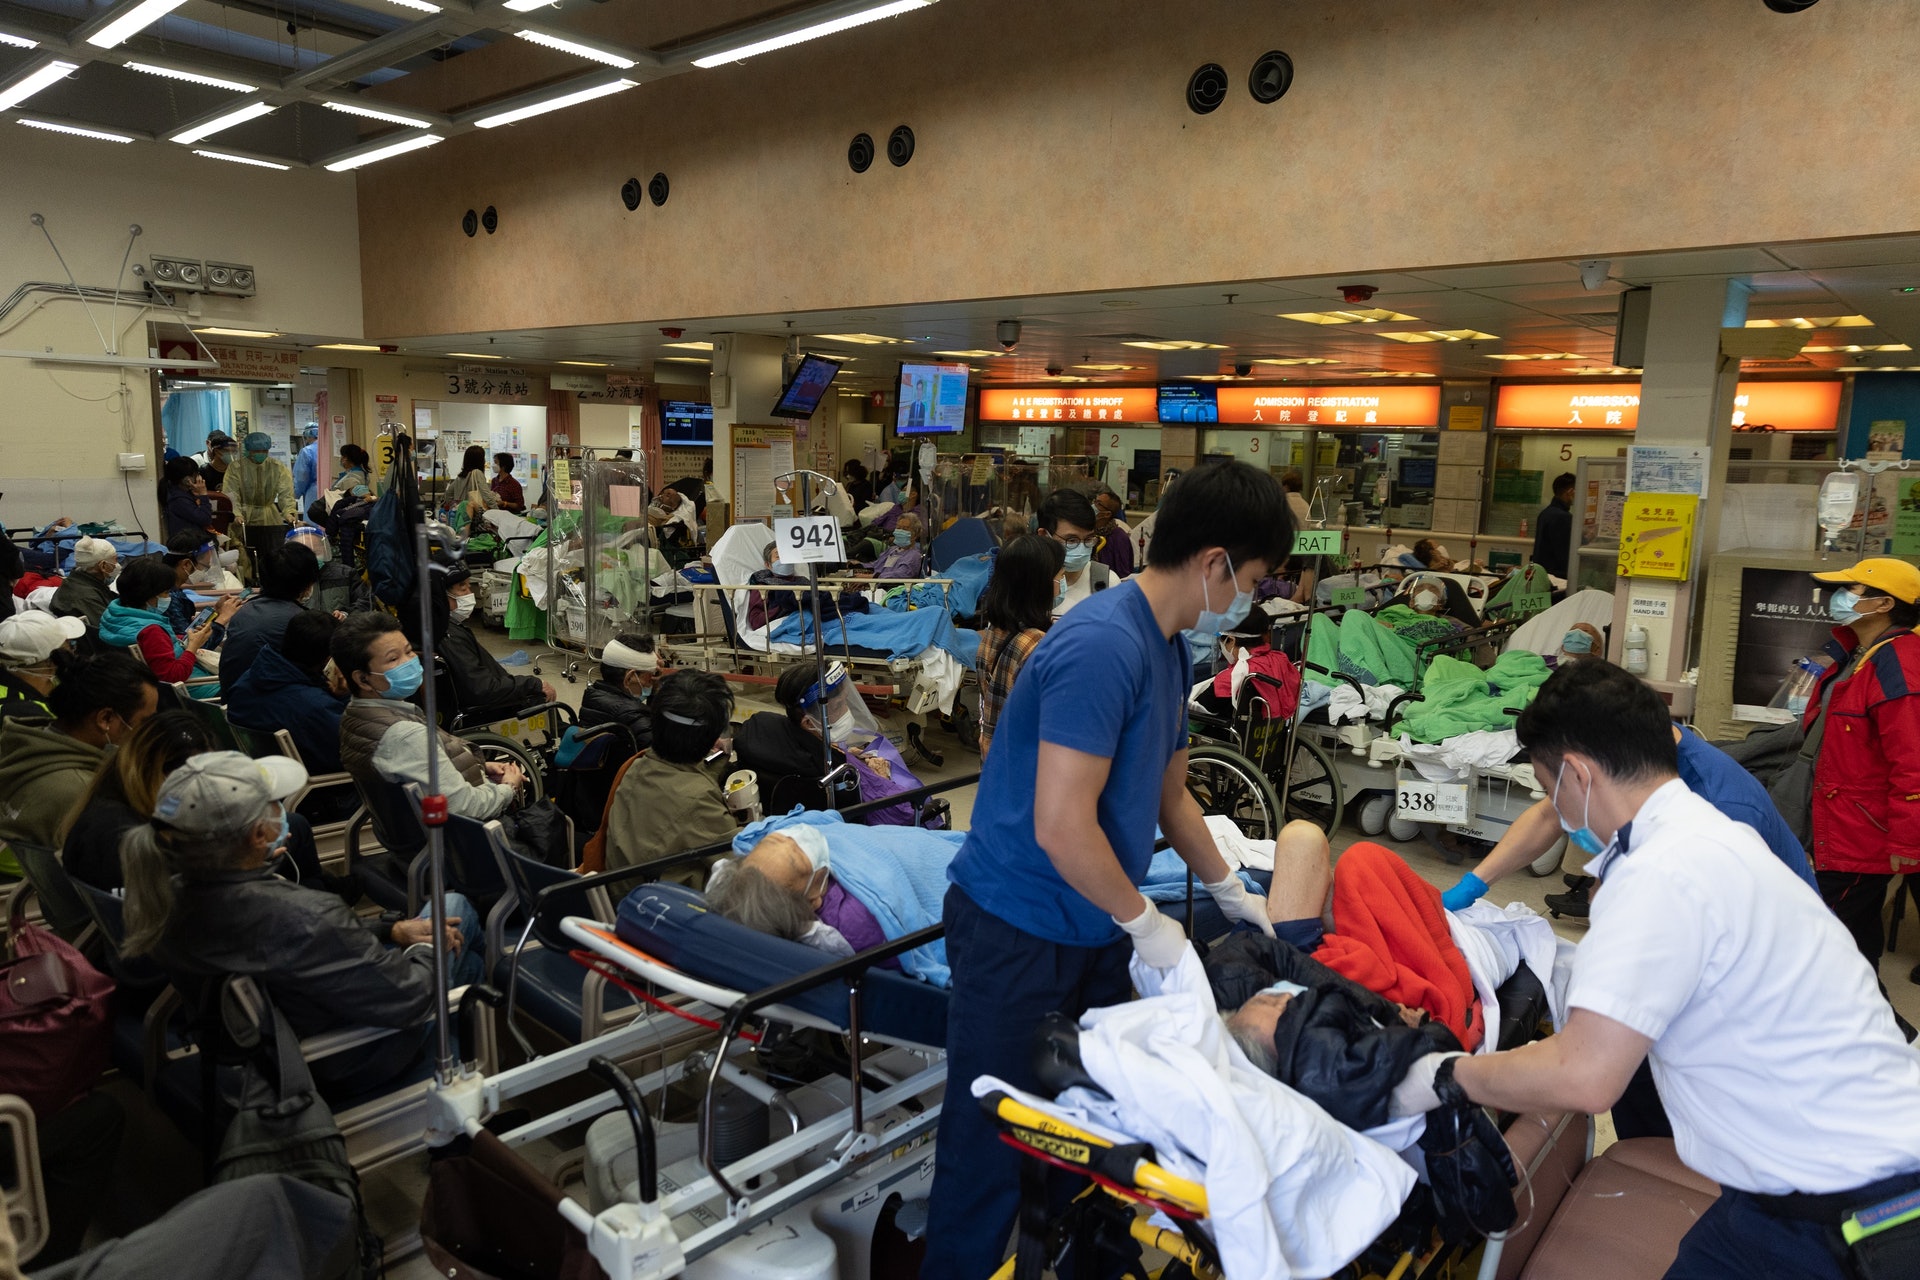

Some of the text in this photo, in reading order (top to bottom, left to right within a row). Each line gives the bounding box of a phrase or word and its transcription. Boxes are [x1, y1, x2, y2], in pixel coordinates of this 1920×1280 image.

[220, 362, 258, 370] ULTATION
[1013, 397, 1124, 406] A & E REGISTRATION & SHROFF
[1254, 397, 1379, 406] ADMISSION REGISTRATION
[1110, 434, 1120, 448] 2
[1250, 437, 1259, 452] 3
[382, 446, 395, 464] 3
[1560, 444, 1572, 461] 5
[790, 524, 835, 549] 942
[1298, 537, 1331, 551] RAT
[1340, 592, 1357, 600] RAT
[493, 598, 503, 607] 414
[1520, 597, 1544, 609] RAT
[570, 621, 584, 632] 390
[829, 670, 842, 683] Face
[1398, 791, 1436, 812] 338
[1456, 826, 1483, 837] stryker
